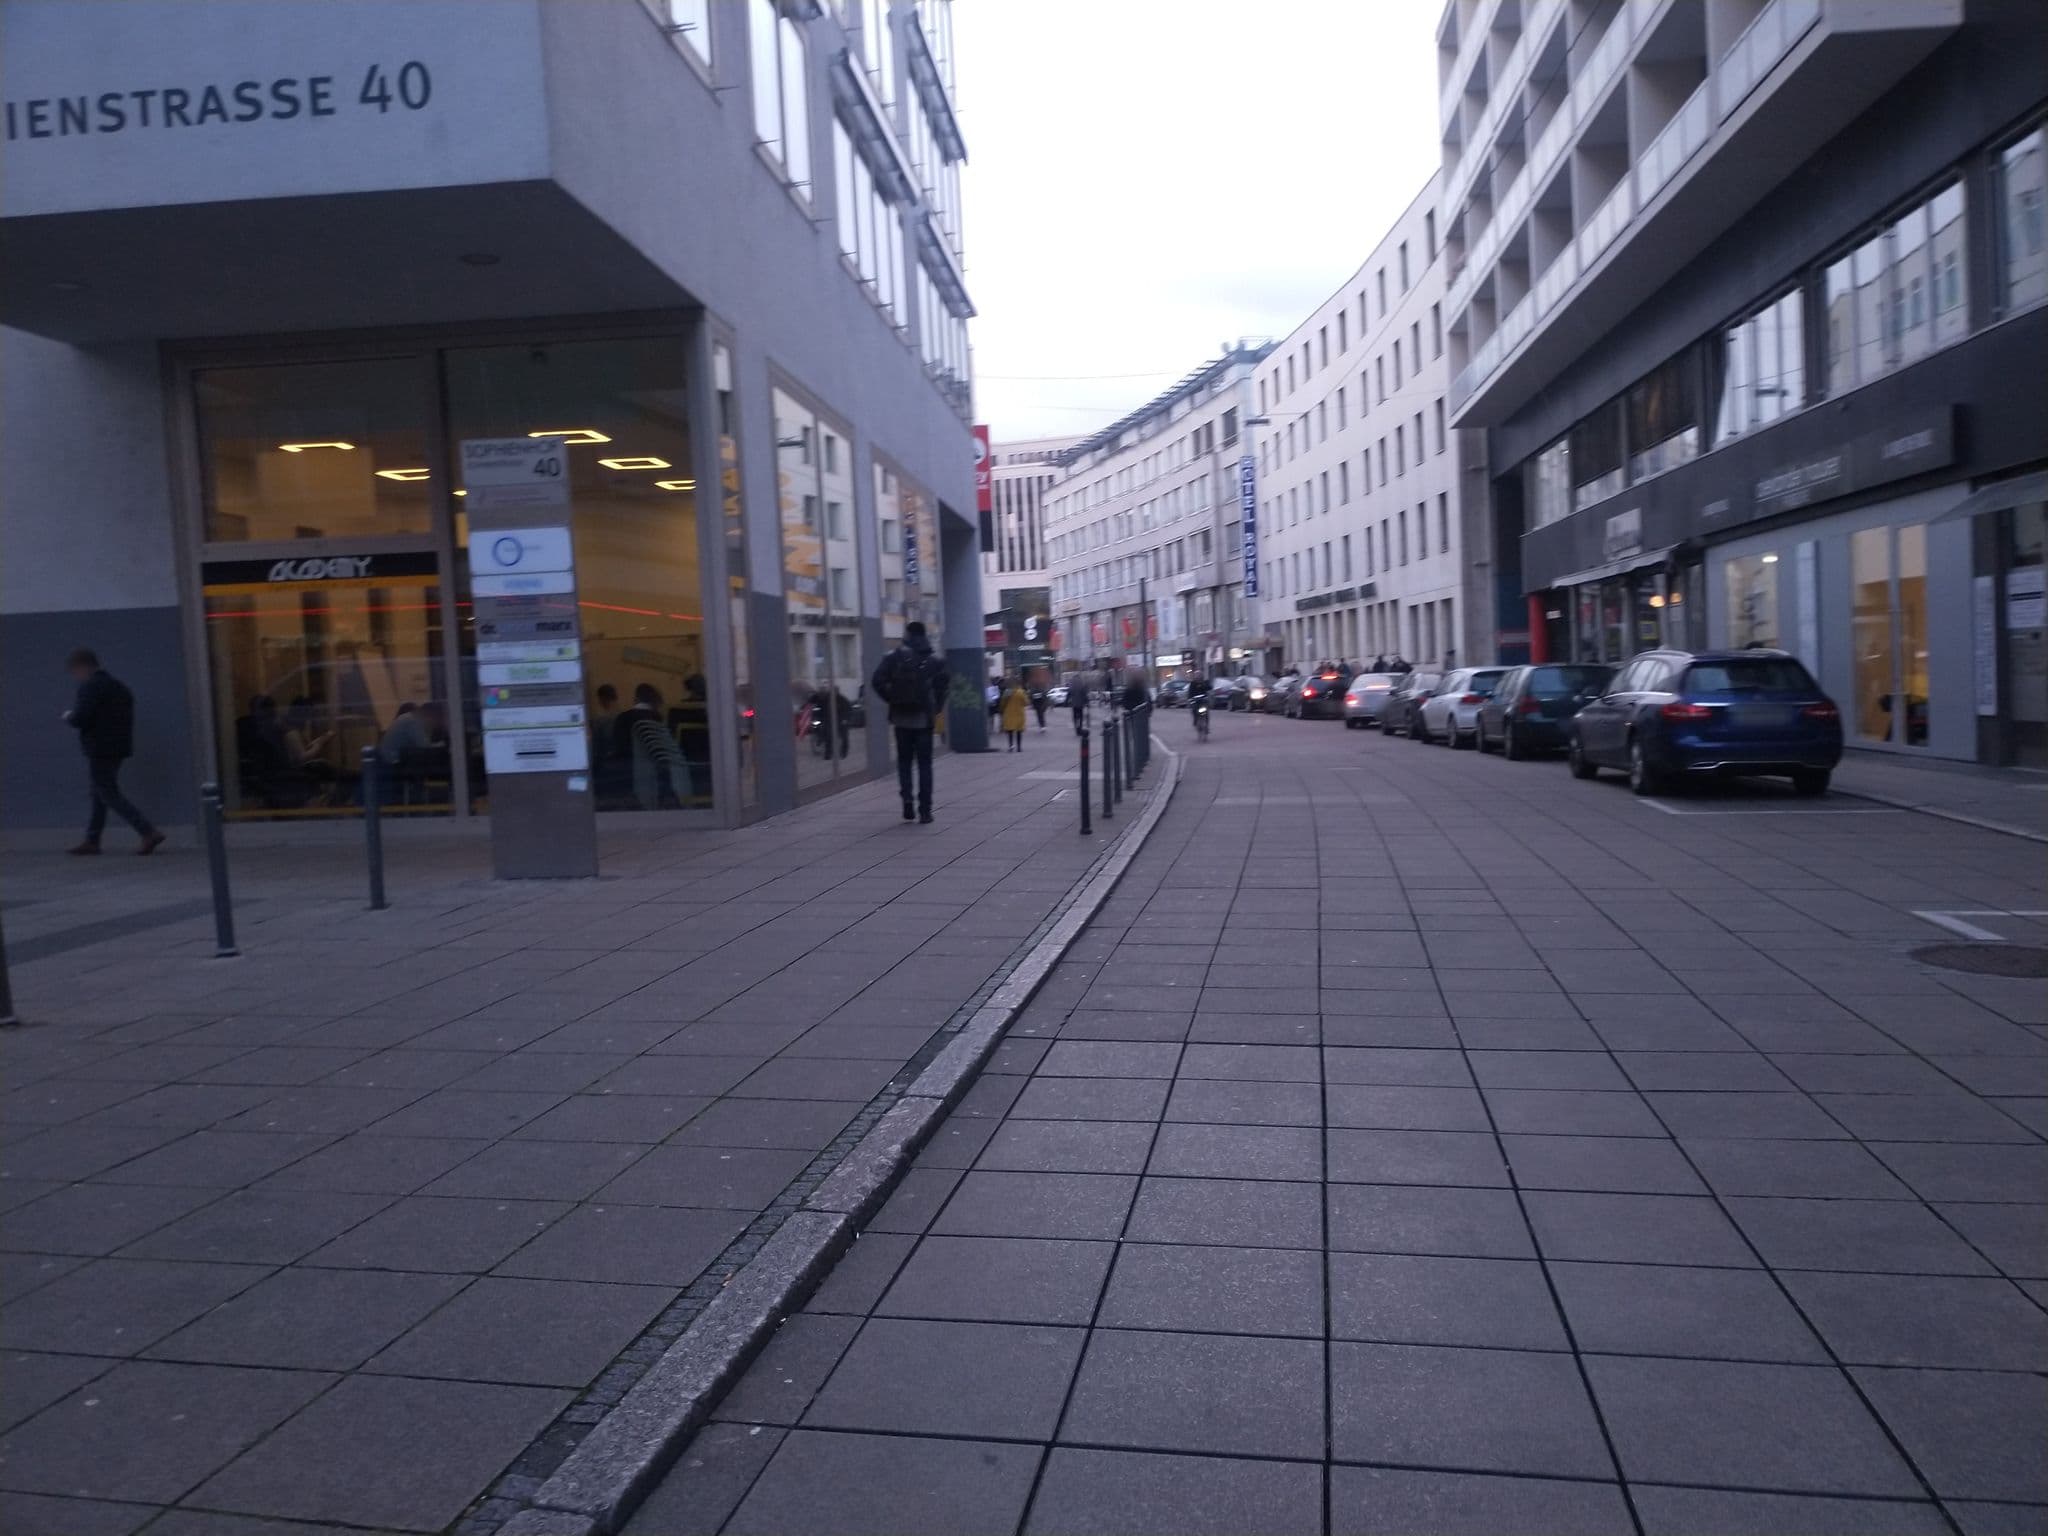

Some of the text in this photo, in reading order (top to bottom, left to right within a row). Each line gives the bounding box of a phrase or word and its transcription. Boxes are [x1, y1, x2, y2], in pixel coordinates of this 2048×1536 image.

[7, 60, 432, 141] IENSTRASSE 40
[533, 457, 560, 477] 40
